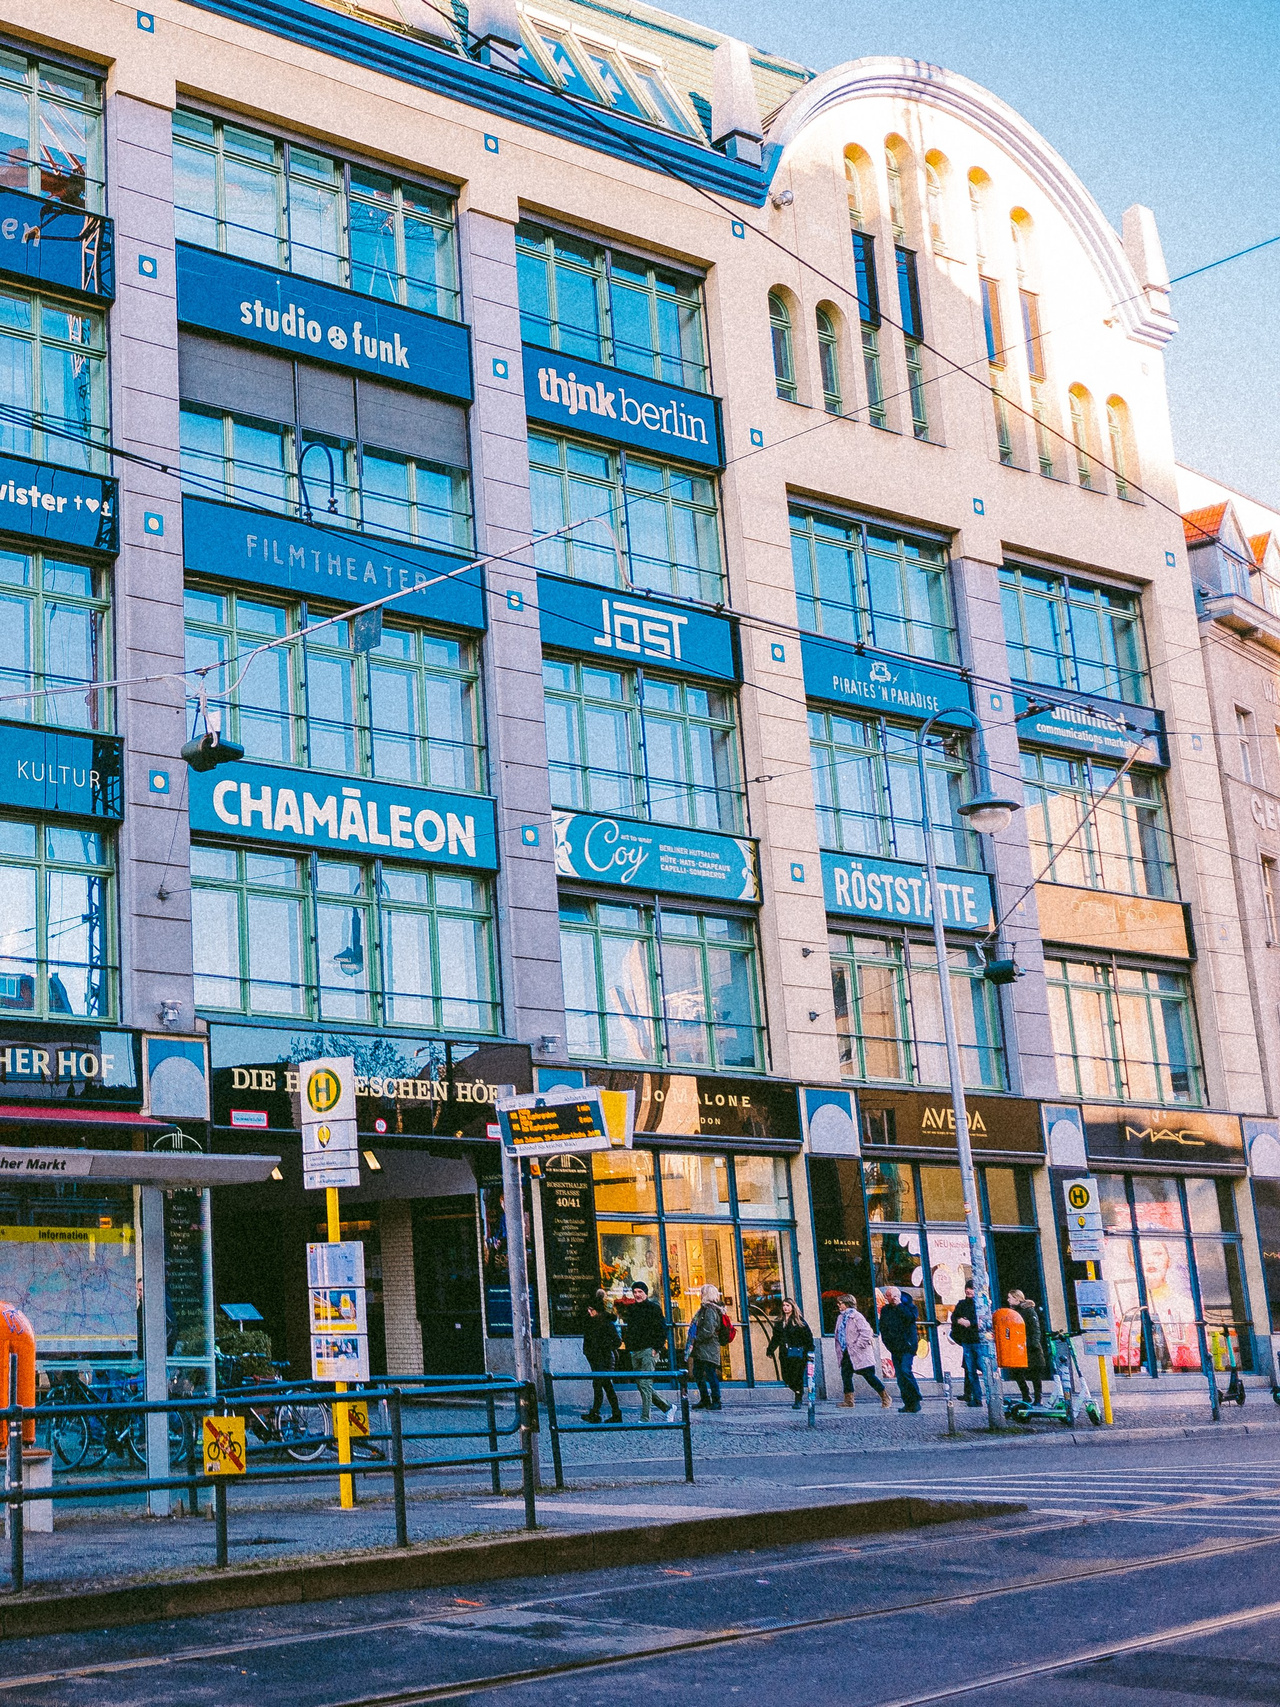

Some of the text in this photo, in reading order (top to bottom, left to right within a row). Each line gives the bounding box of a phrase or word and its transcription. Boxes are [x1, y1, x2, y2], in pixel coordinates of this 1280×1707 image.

[240, 299, 411, 370] studio funk
[619, 387, 710, 445] berlin
[246, 533, 430, 596] FILMTHEATER
[594, 598, 689, 661] JOST
[832, 675, 877, 698] PIRATES
[887, 687, 940, 712] PARADISE
[1036, 722, 1104, 744] communications
[17, 760, 101, 790] KULTUR
[585, 819, 650, 884] Coy
[58, 1049, 115, 1079] HOF
[231, 1067, 277, 1092] DIE
[455, 1078, 499, 1104] HÖF
[672, 1086, 752, 1108] MALONE
[27, 1158, 67, 1171] Markt
[556, 1197, 581, 1208] 40/41
[38, 1229, 89, 1240] Information
